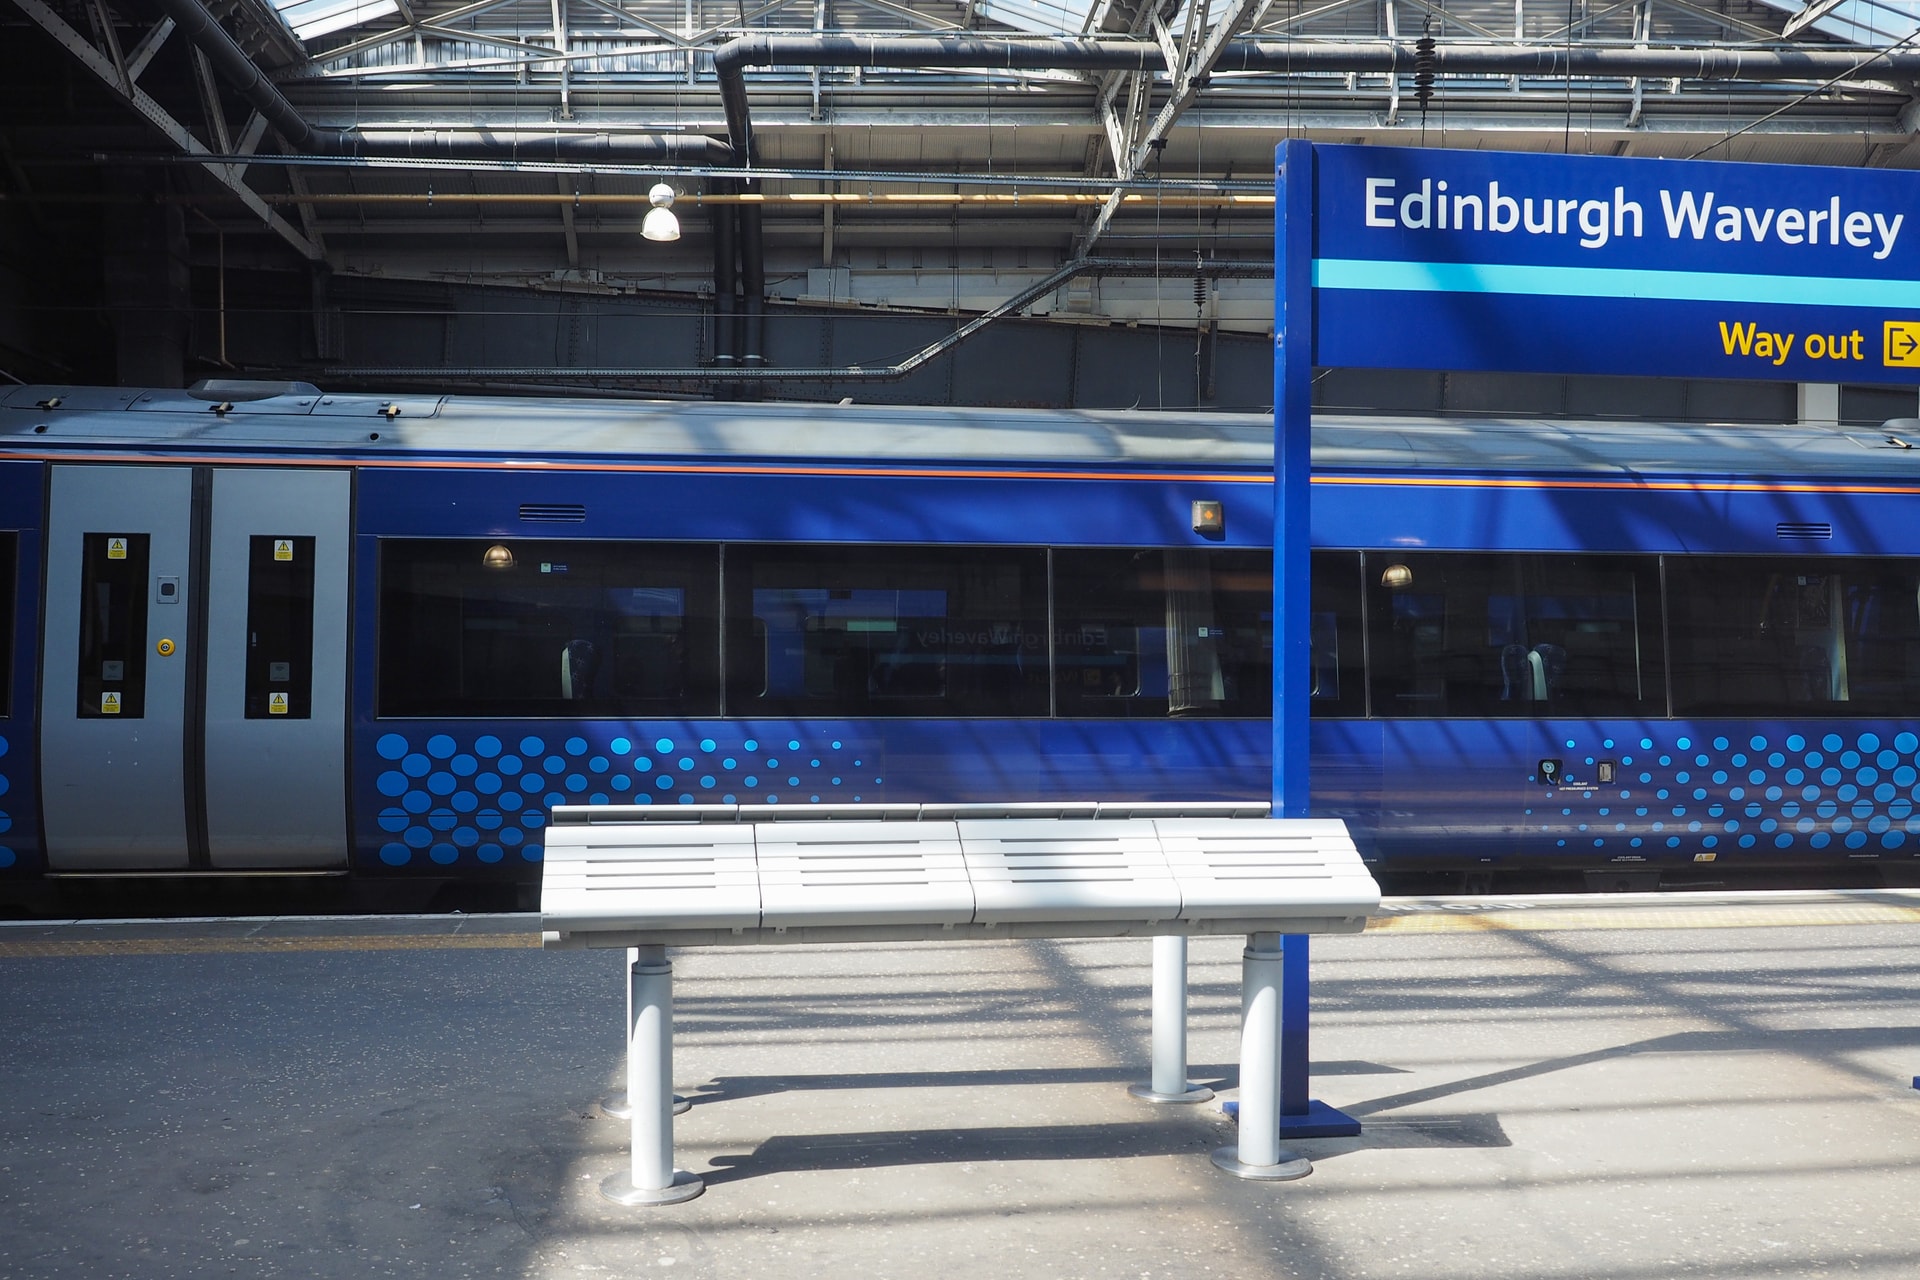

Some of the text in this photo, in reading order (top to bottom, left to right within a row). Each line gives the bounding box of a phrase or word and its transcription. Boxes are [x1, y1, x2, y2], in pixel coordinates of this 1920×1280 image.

[1365, 177, 1904, 260] Edinburgh Waverley
[1719, 321, 1865, 366] Way out
